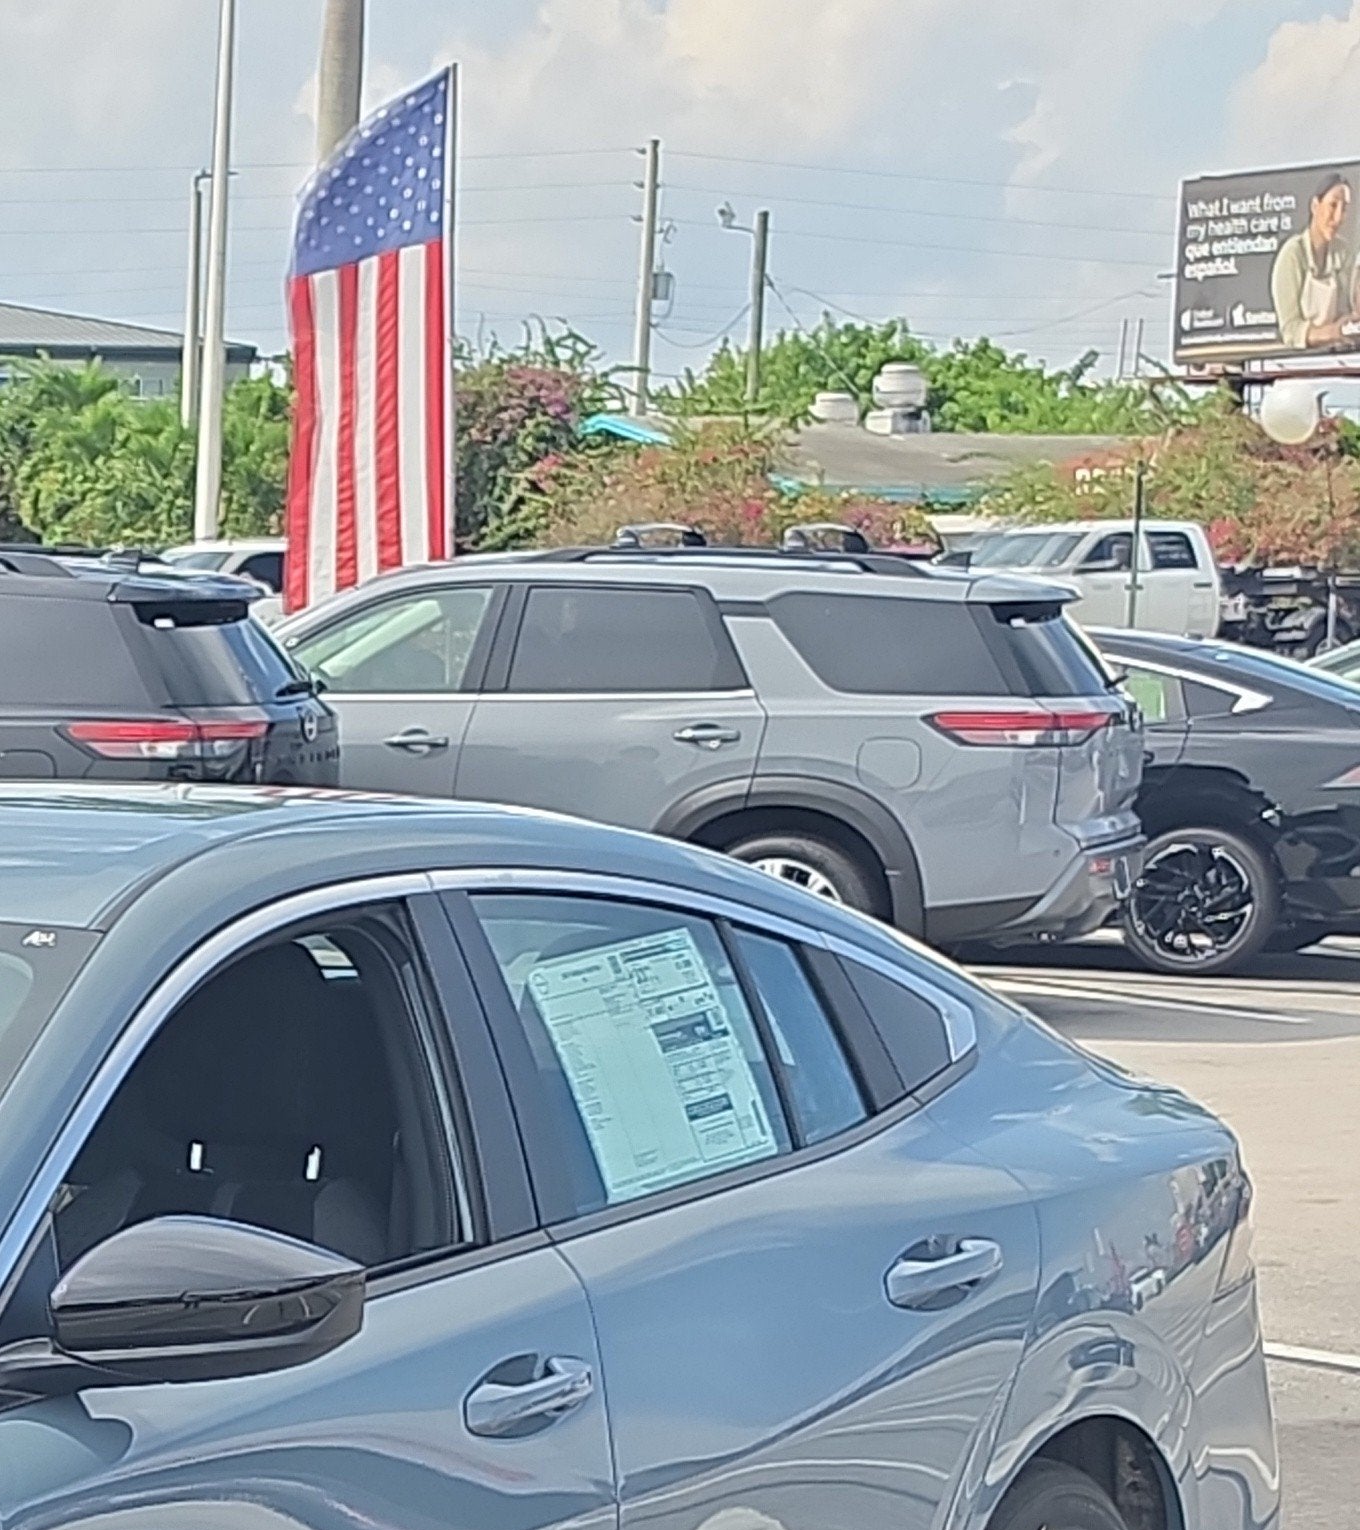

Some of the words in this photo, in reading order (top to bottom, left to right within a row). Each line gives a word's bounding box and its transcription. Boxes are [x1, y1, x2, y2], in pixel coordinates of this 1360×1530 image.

[1187, 199, 1221, 219] What
[1222, 197, 1229, 216] I
[1230, 195, 1262, 214] want
[1263, 192, 1296, 211] from
[1186, 223, 1206, 242] my
[1208, 218, 1248, 237] health
[1250, 216, 1279, 233] care
[1280, 213, 1292, 230] is
[1185, 242, 1210, 262] que
